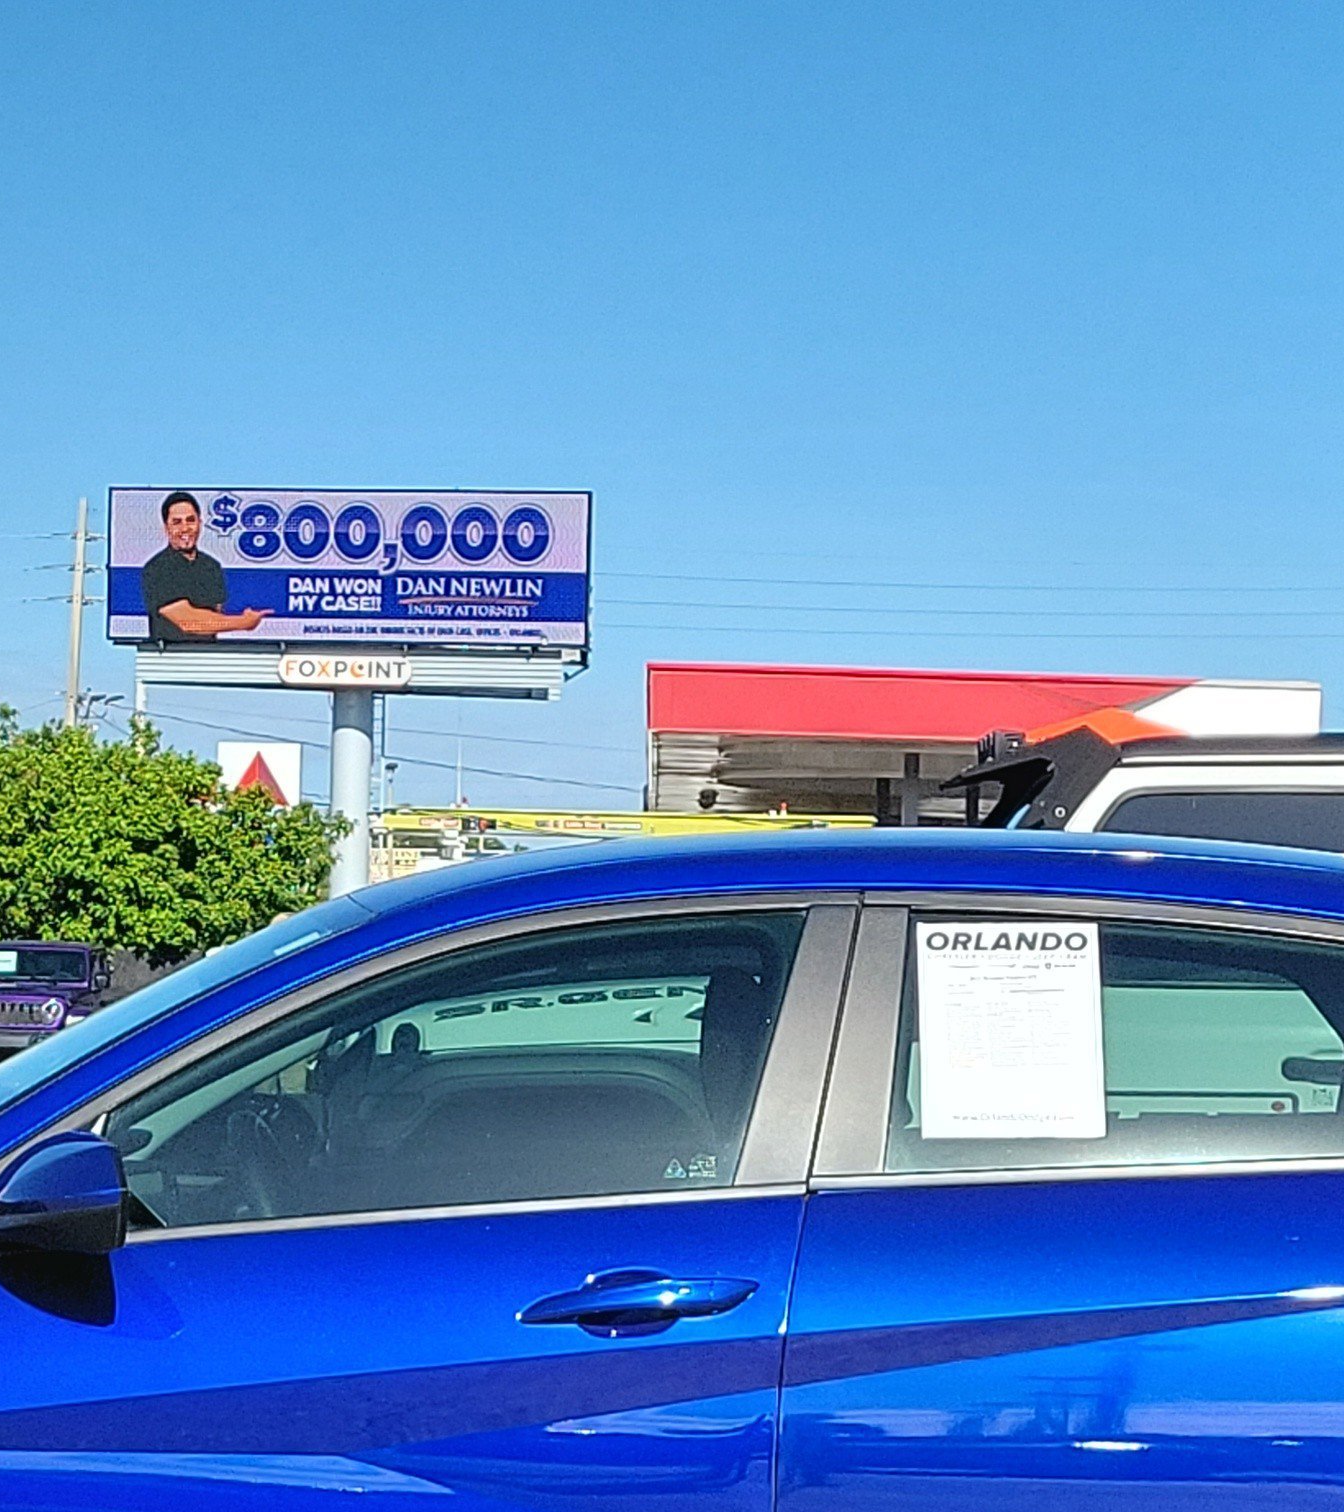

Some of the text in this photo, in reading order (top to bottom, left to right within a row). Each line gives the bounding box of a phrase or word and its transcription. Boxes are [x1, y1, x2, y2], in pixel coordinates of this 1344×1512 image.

[209, 494, 552, 573] $800,000
[289, 577, 382, 595] DAN WON
[396, 577, 544, 597] DAN NEWLIN
[289, 595, 382, 612] MY CASE!!
[456, 605, 529, 618] ATTORNEYS
[925, 931, 1088, 951] ORLANDO
